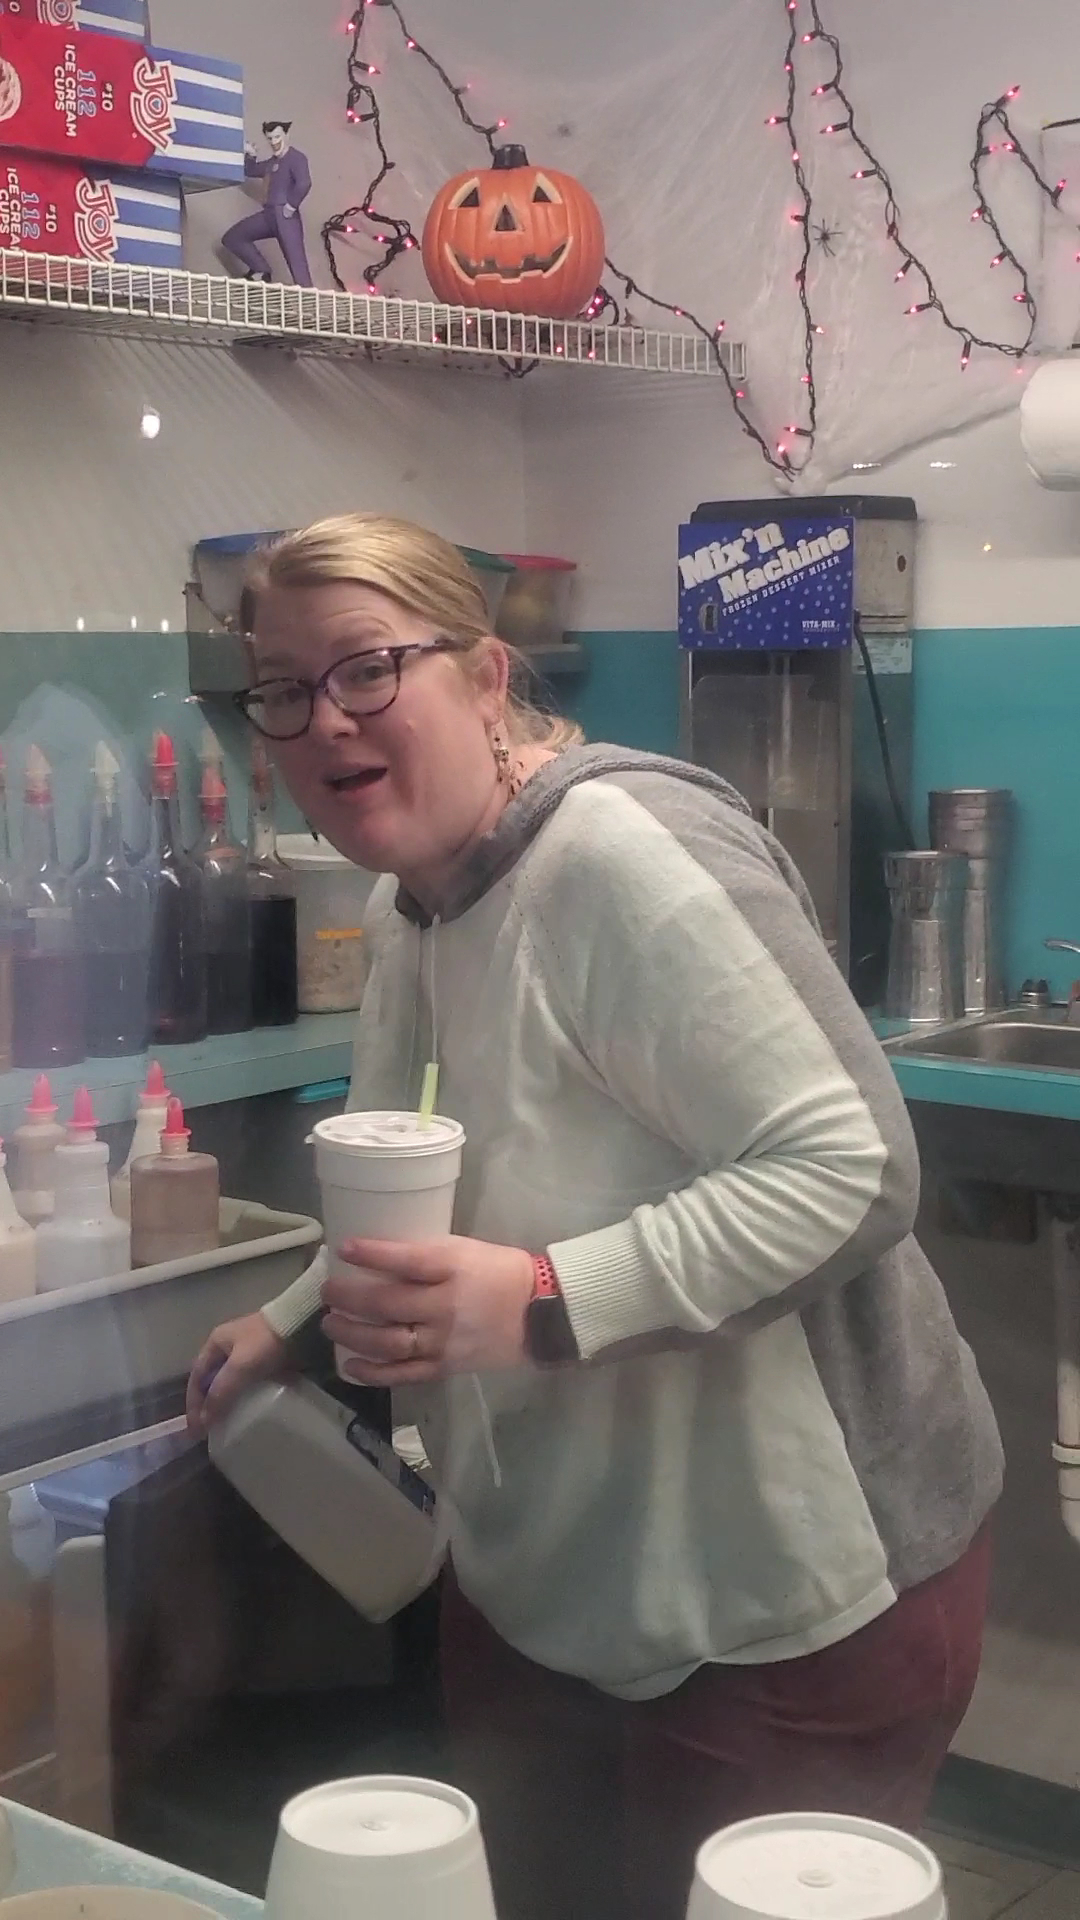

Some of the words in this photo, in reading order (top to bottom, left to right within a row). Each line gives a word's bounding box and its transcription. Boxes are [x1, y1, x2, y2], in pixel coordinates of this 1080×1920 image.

[65, 43, 76, 74] ICE
[54, 65, 65, 111] CUPS
[65, 78, 77, 137] CREAM
[77, 69, 97, 118] 112
[101, 82, 114, 111] #10
[130, 57, 177, 154] JOY
[6, 167, 20, 195] ICE
[0, 189, 10, 234] CUPS
[21, 191, 40, 239] 112
[45, 203, 57, 233] #10
[74, 177, 119, 263] JOY
[678, 522, 785, 590] Mix'n
[717, 527, 851, 604] Machine
[721, 593, 759, 617] FROZEN
[761, 571, 806, 599] DESSERT
[809, 555, 841, 577] MIXER
[801, 620, 836, 629] VITA-MIX
